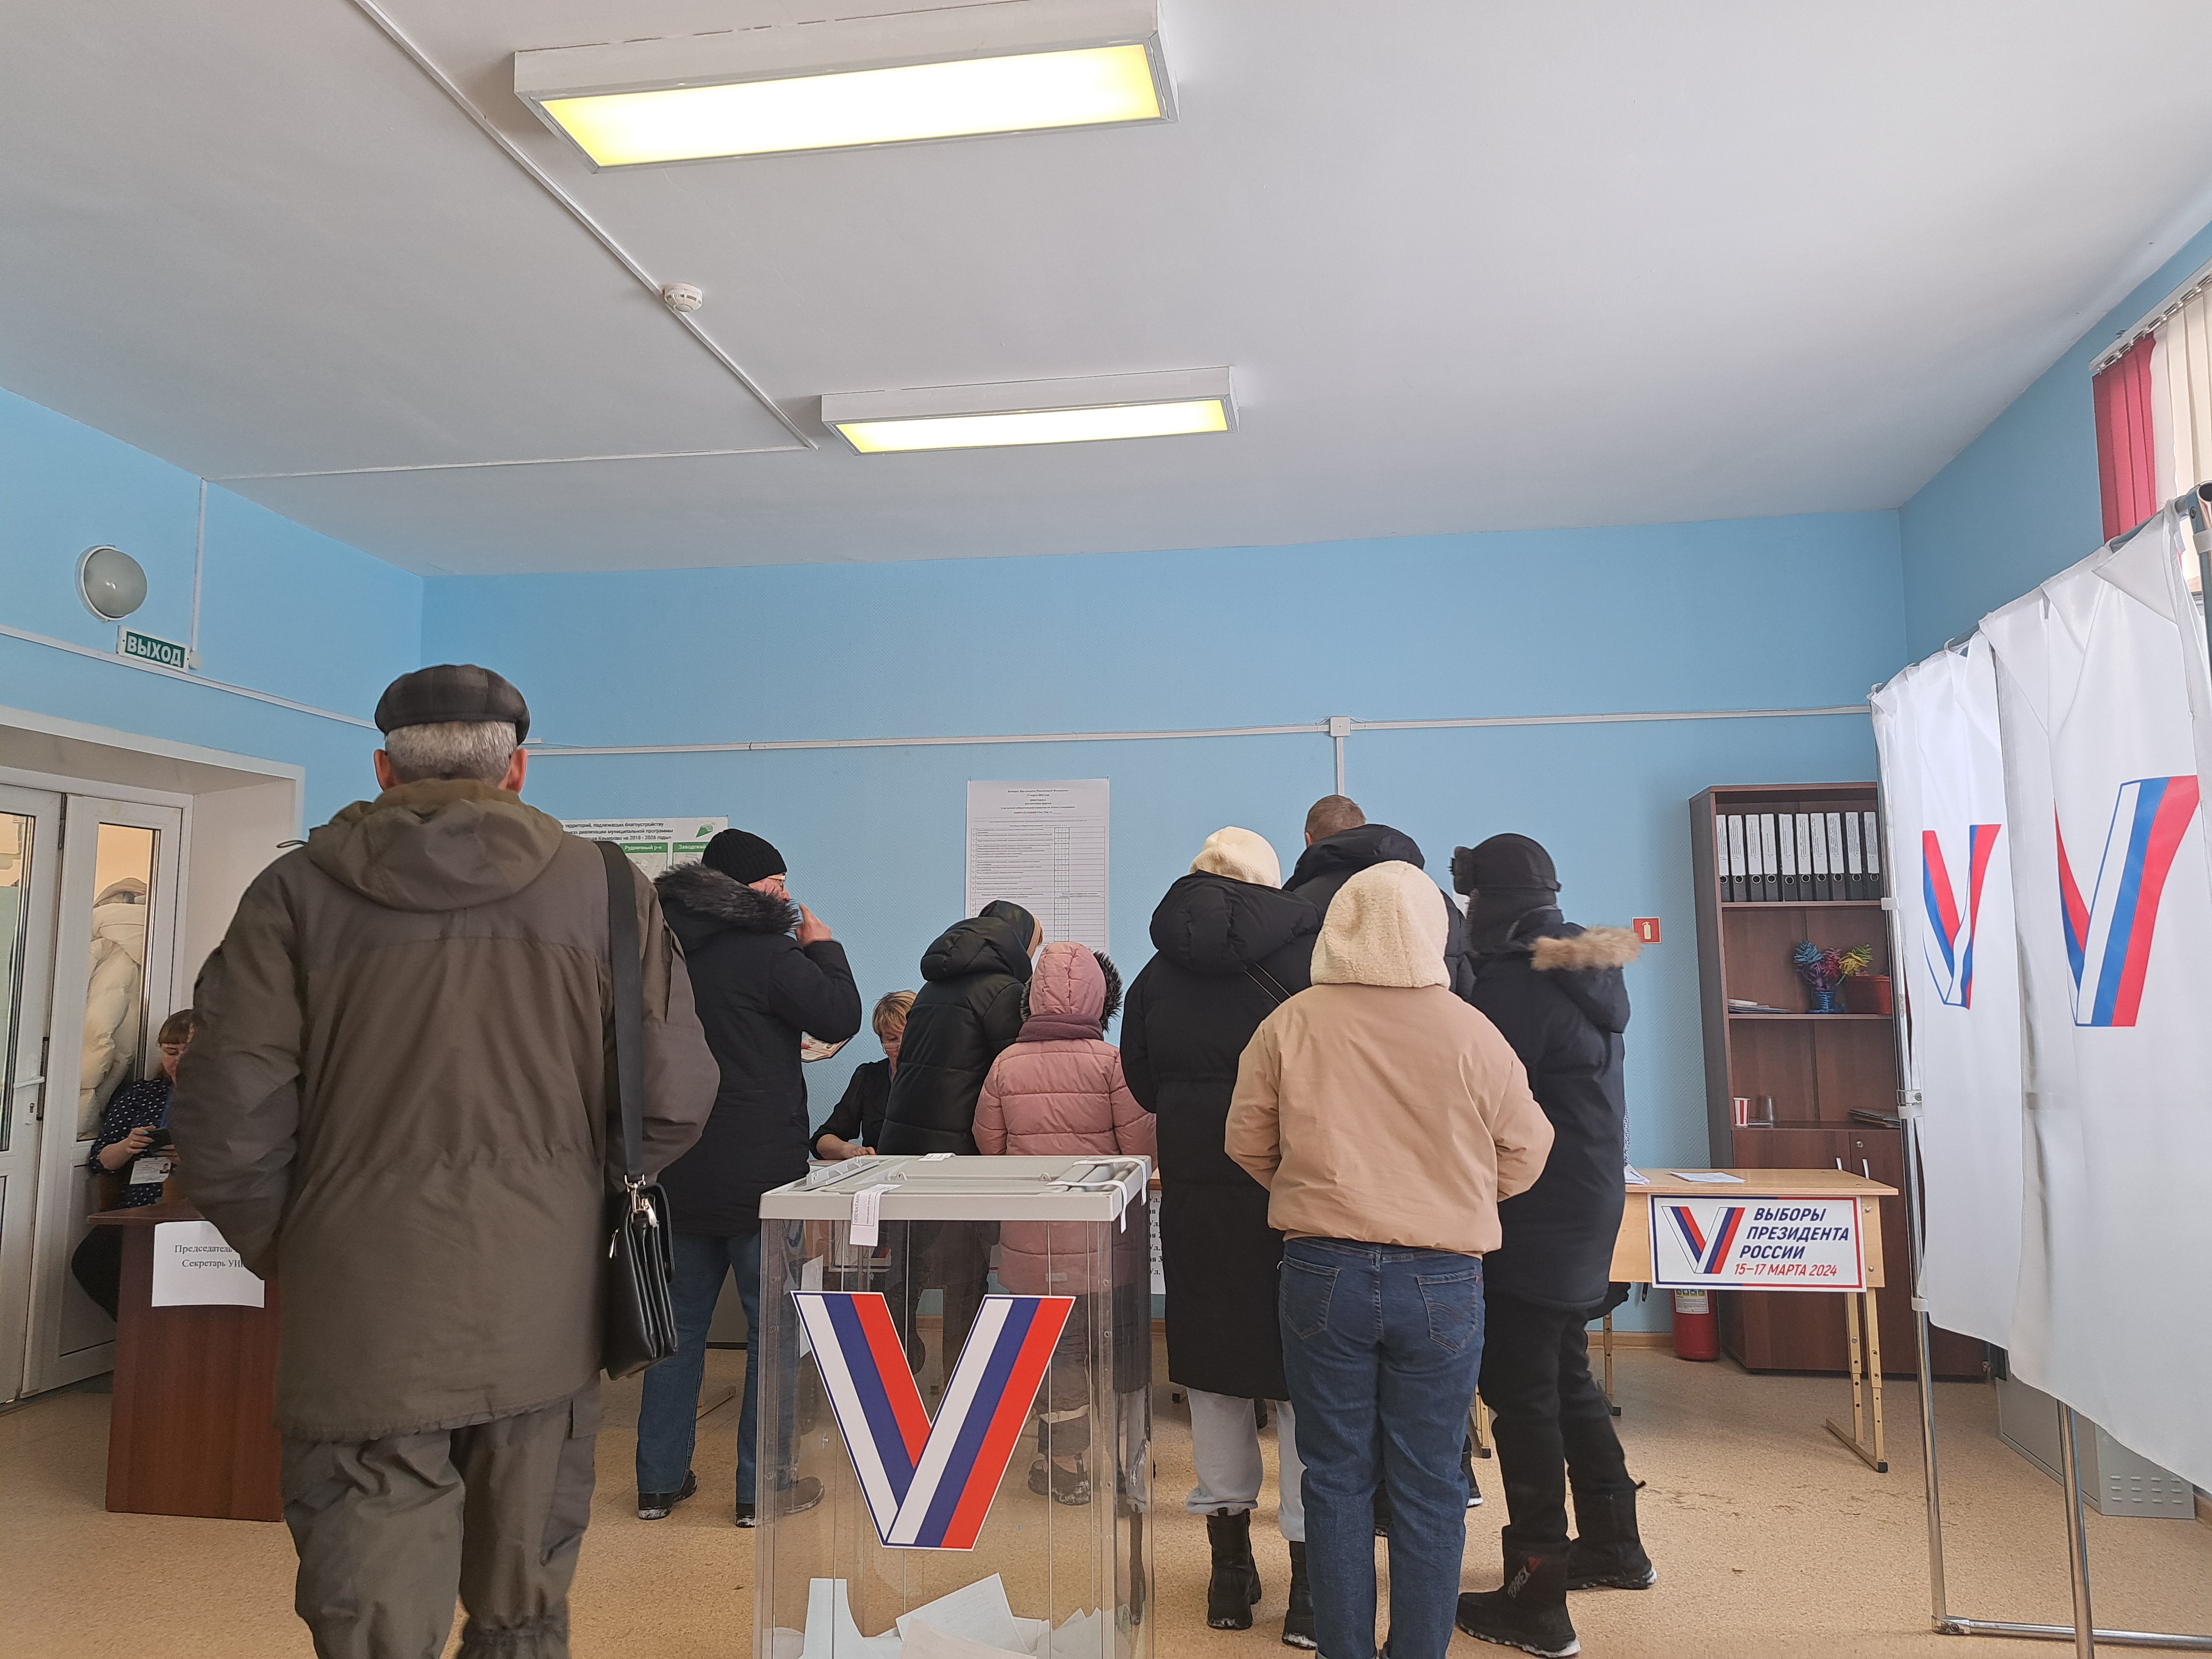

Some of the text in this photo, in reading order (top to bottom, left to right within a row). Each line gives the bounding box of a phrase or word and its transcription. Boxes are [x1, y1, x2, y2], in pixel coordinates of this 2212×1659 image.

[127, 635, 181, 667] ВЫХОД
[1753, 1207, 1827, 1221] ВЫБОРЫ
[1746, 1227, 1849, 1242] ПРЕЗИДЕНТА
[175, 1245, 232, 1254] Председатель
[1739, 1245, 1805, 1259] РОССИИ
[182, 1260, 226, 1269] Секретарь
[1768, 1264, 1806, 1276] МАРТА
[1809, 1264, 1837, 1277] 2024
